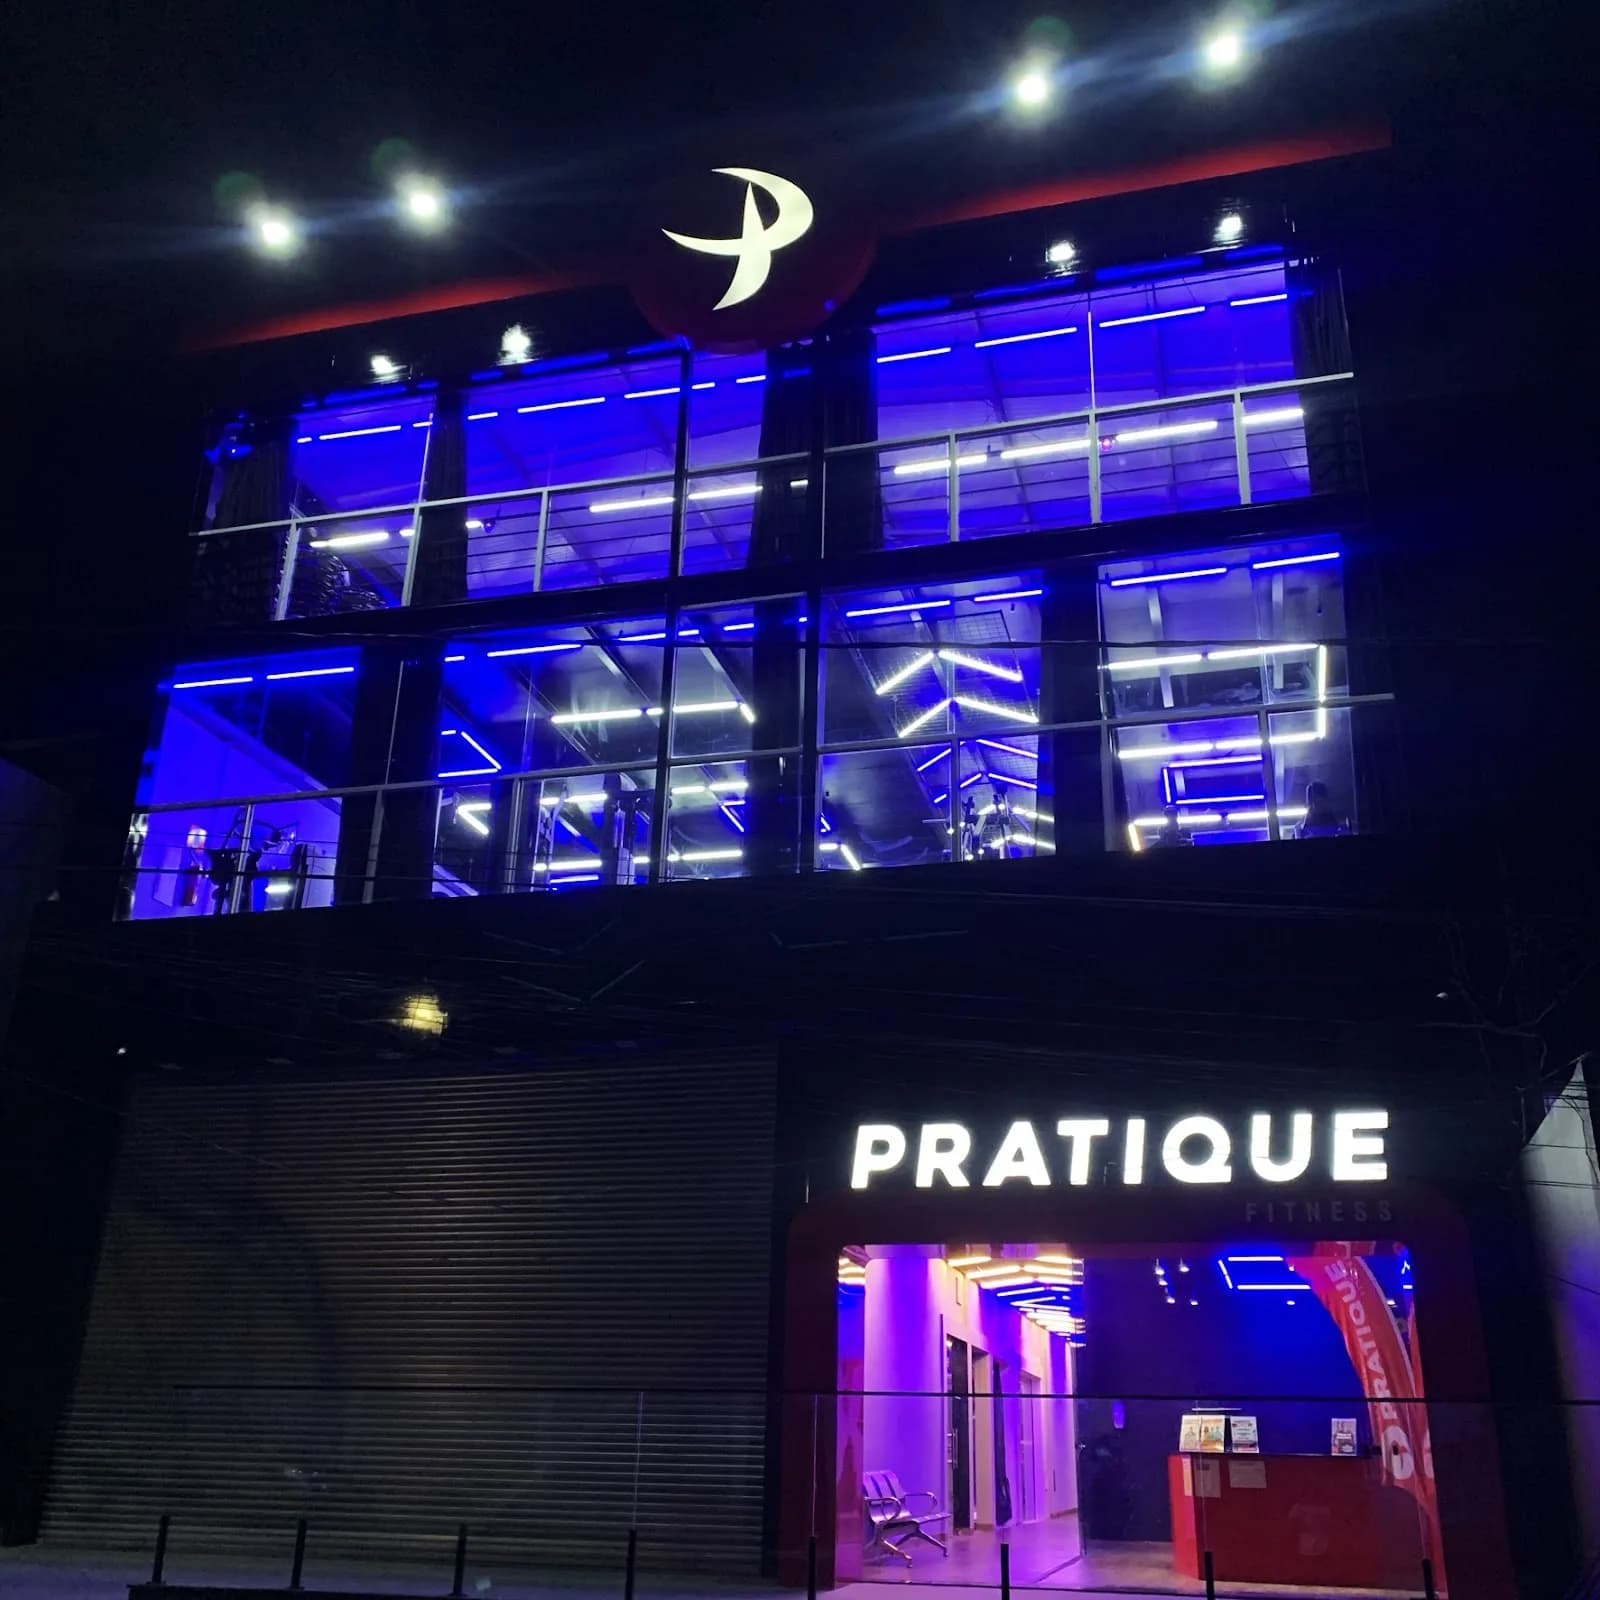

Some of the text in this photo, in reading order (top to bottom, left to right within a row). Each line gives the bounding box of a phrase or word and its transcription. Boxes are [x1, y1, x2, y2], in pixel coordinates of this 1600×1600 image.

[850, 1110, 1389, 1189] PRATIQUE
[1245, 1200, 1393, 1223] FITNESS
[1323, 1259, 1398, 1420] PRATIQUE
